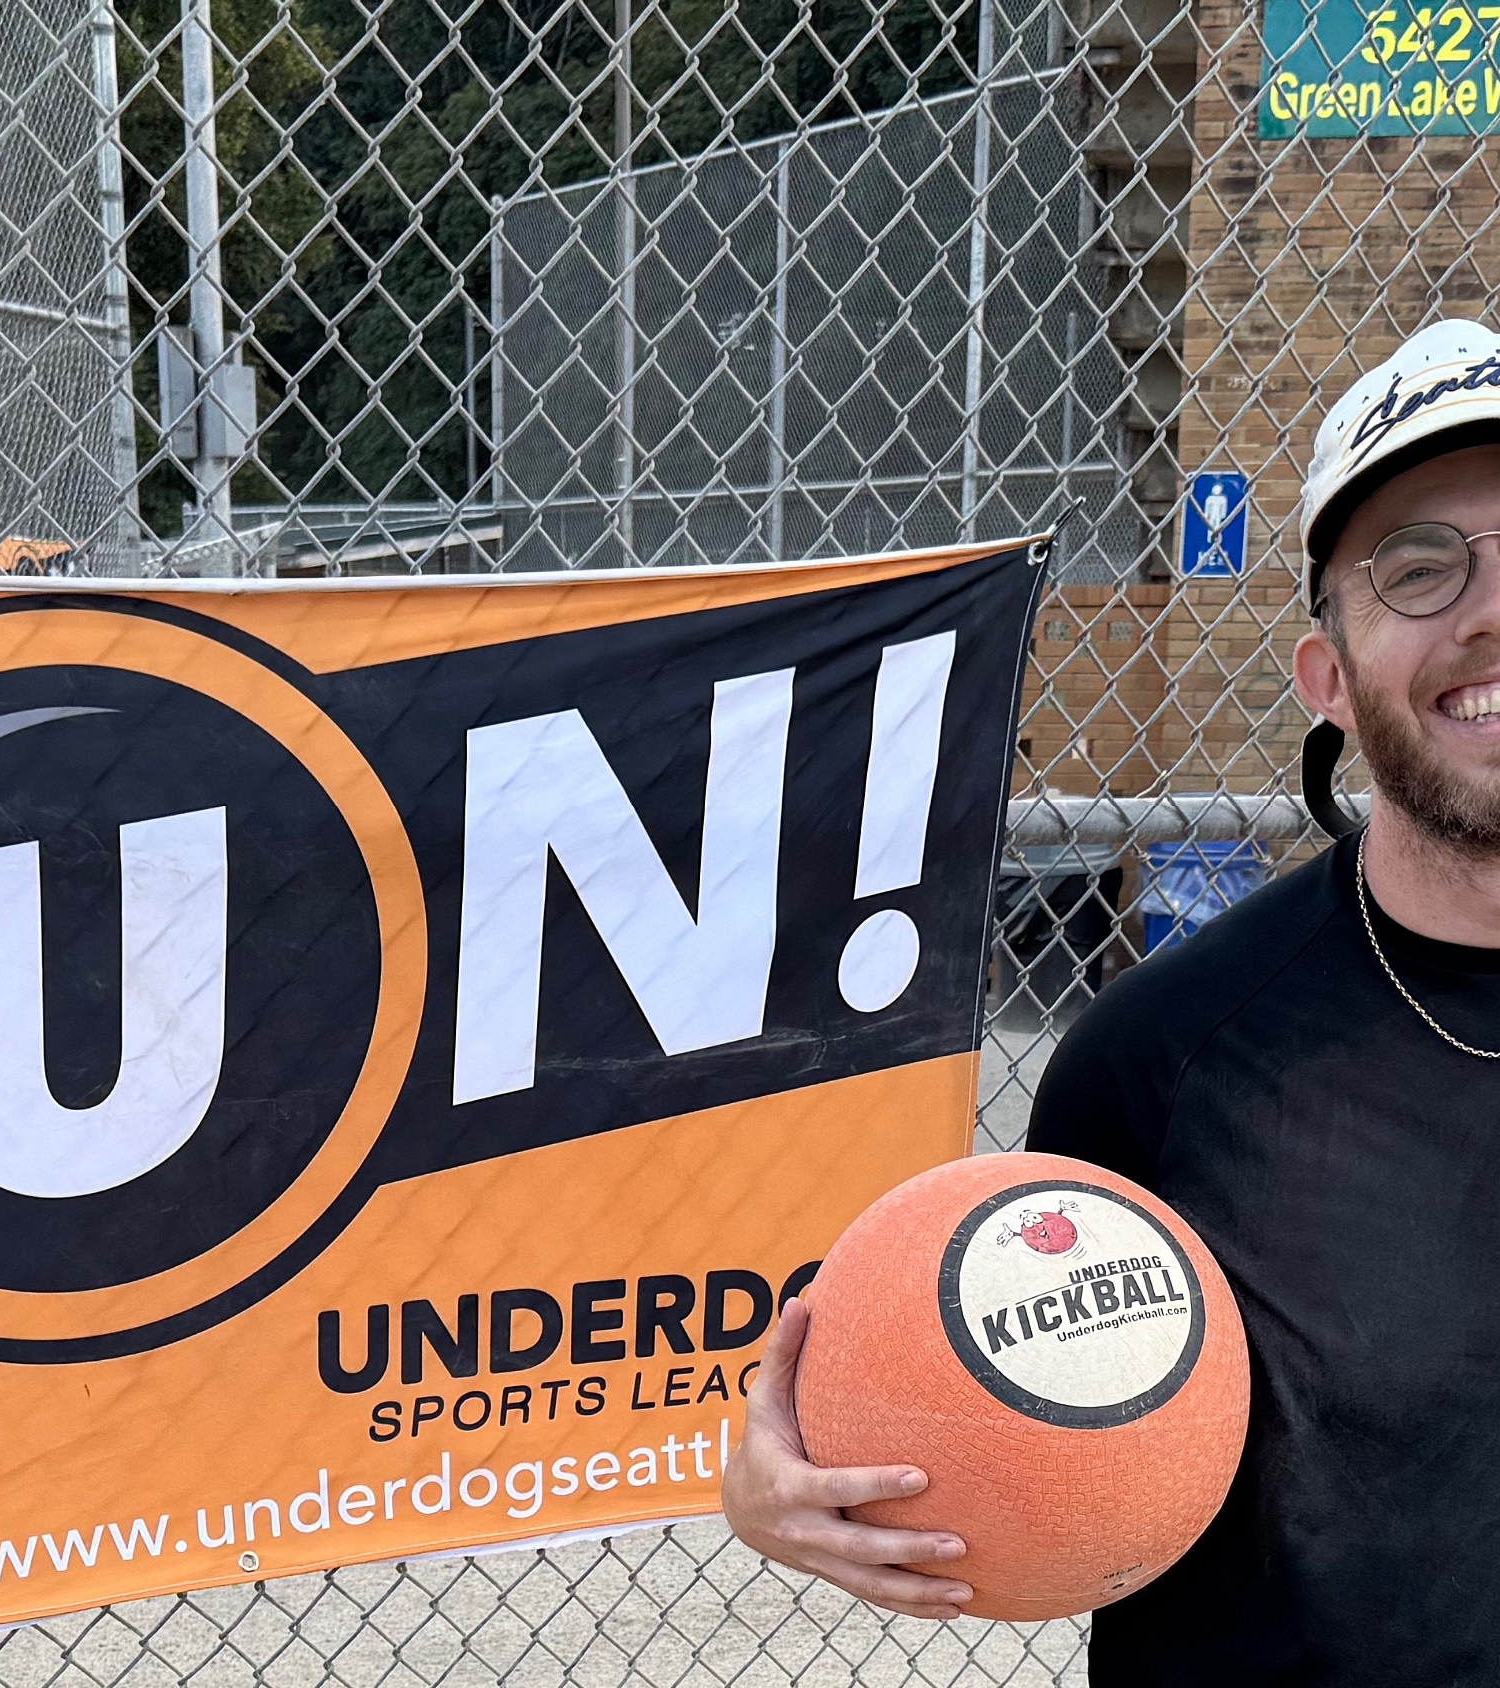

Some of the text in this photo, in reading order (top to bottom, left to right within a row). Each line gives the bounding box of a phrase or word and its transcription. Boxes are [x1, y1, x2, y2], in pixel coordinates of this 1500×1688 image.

[1269, 72, 1384, 120] Green
[1388, 68, 1476, 118] Lake
[1068, 1255, 1162, 1285] UNDERDOG
[981, 1269, 1185, 1355] KICKBALL
[1056, 1306, 1188, 1342] UnderdogKickball.com
[368, 1375, 606, 1443] SPORTS
